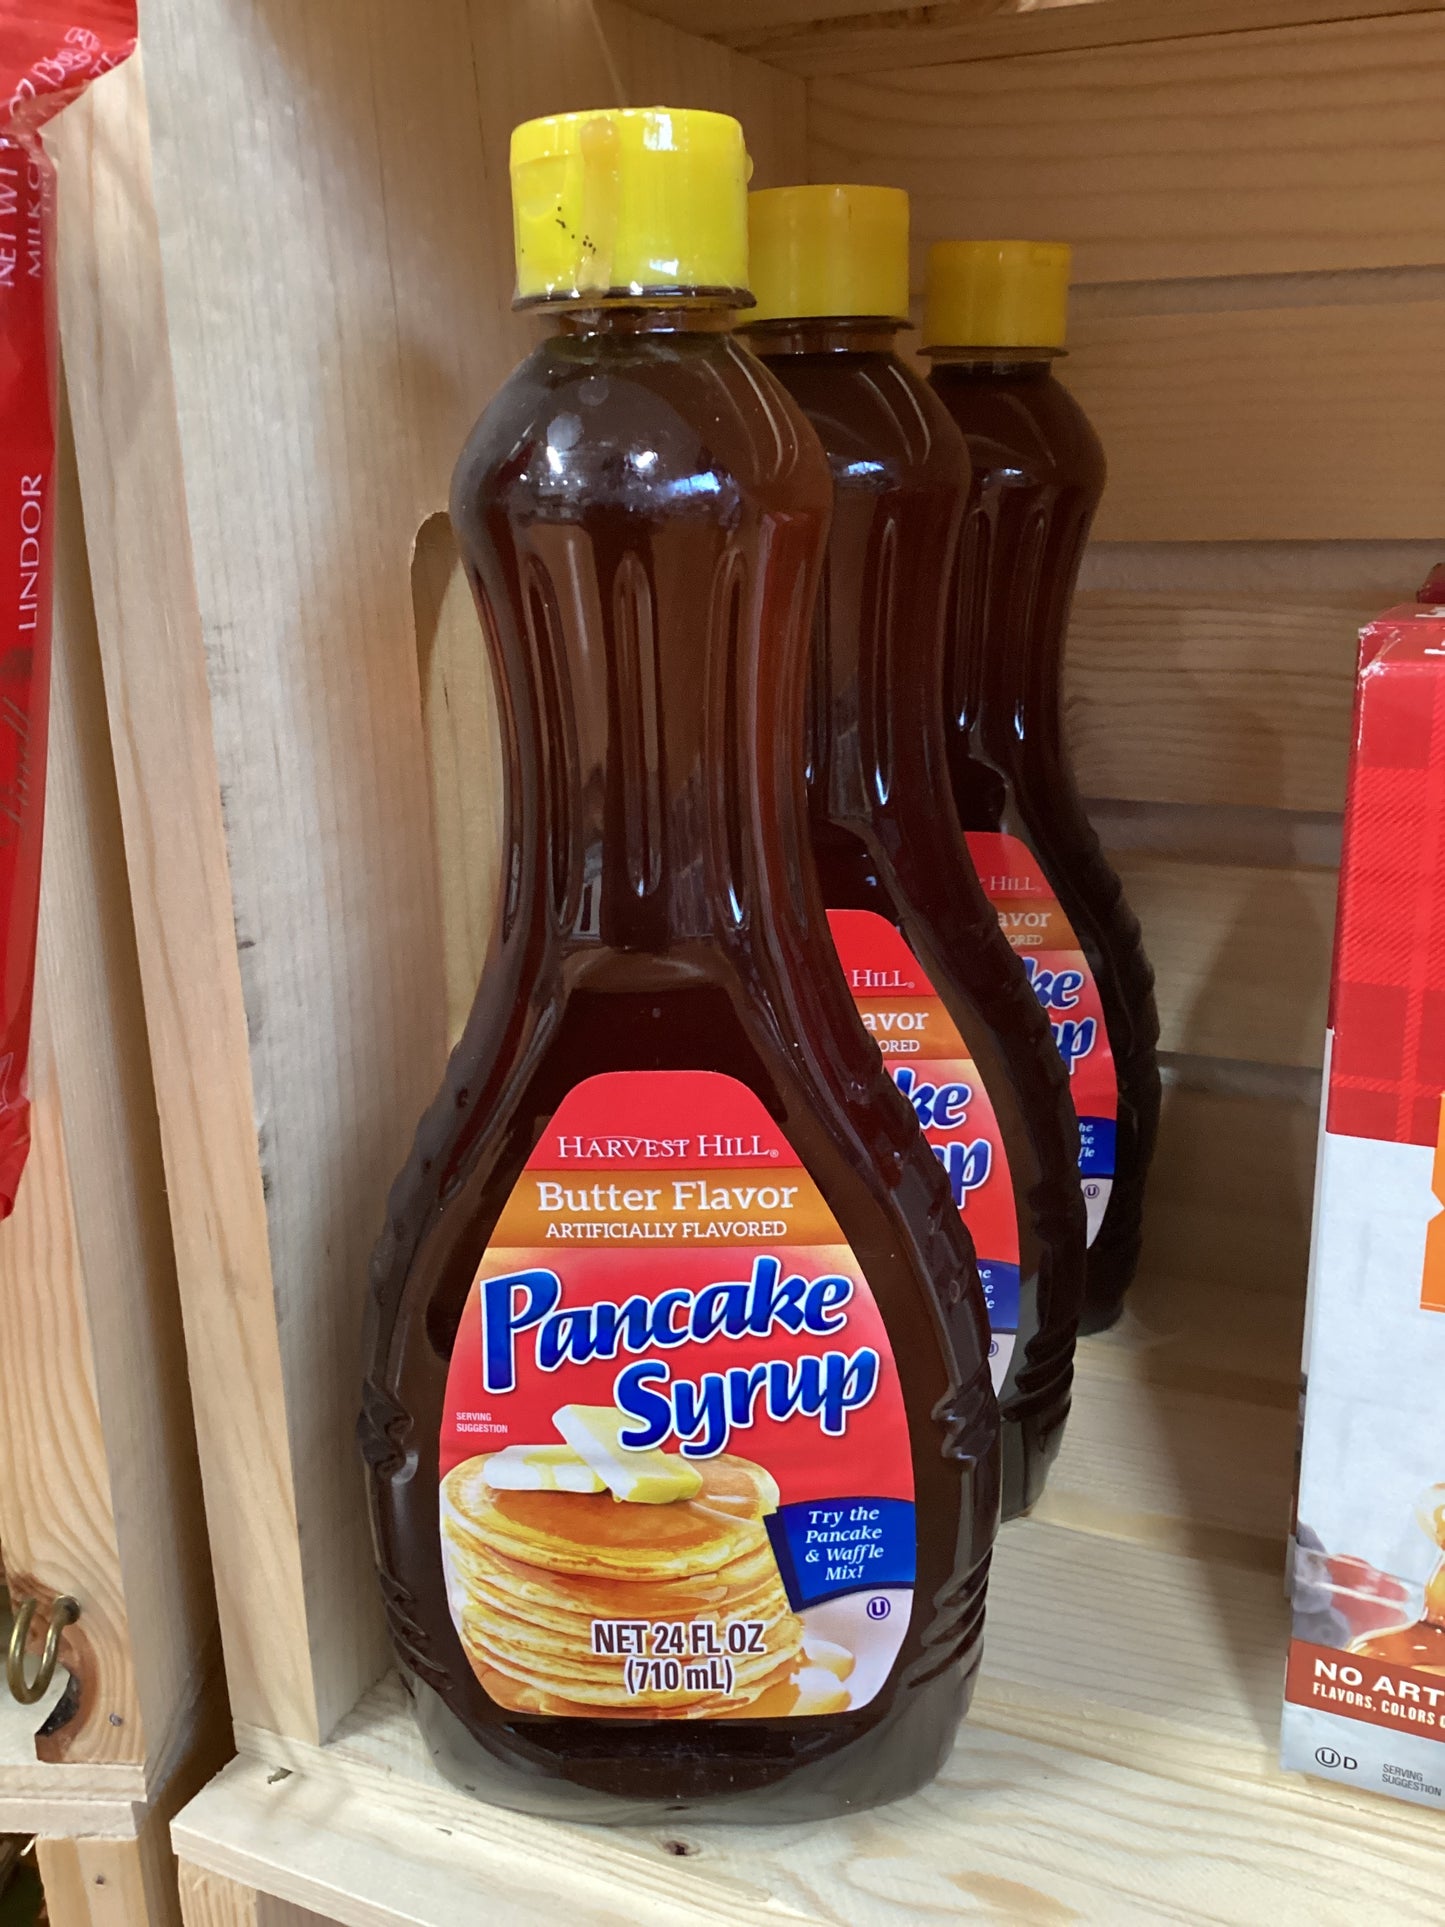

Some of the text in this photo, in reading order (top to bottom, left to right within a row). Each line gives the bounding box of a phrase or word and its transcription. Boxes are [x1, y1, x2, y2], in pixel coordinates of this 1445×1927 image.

[26, 198, 41, 278] MILK
[18, 473, 42, 631] LINDOR
[998, 912, 1053, 928] avor
[861, 1012, 930, 1031] avor
[878, 1040, 921, 1053] ORED
[557, 1136, 690, 1158] HARVEST
[536, 1180, 798, 1212] Butter Flavor
[545, 1220, 788, 1239] ARTIFICIALLY FLAVORED
[481, 1255, 853, 1395] Pancake
[613, 1347, 880, 1459] Syrup
[456, 1411, 492, 1421] SERVING
[456, 1422, 508, 1433] SUGGESTION
[808, 1506, 880, 1528] Try the
[805, 1525, 883, 1544] Pancake
[805, 1543, 884, 1565] & Waffle
[825, 1565, 865, 1581] Mix!
[592, 1622, 766, 1655] NET 24 FL OZ
[625, 1658, 734, 1695] (710 mL)
[1314, 1658, 1363, 1686] NO
[1312, 1682, 1377, 1712] FLAVORS,
[1381, 1700, 1435, 1726] COLORS
[1382, 1763, 1423, 1782] SERVING
[1382, 1773, 1443, 1797] SUGGESTION
